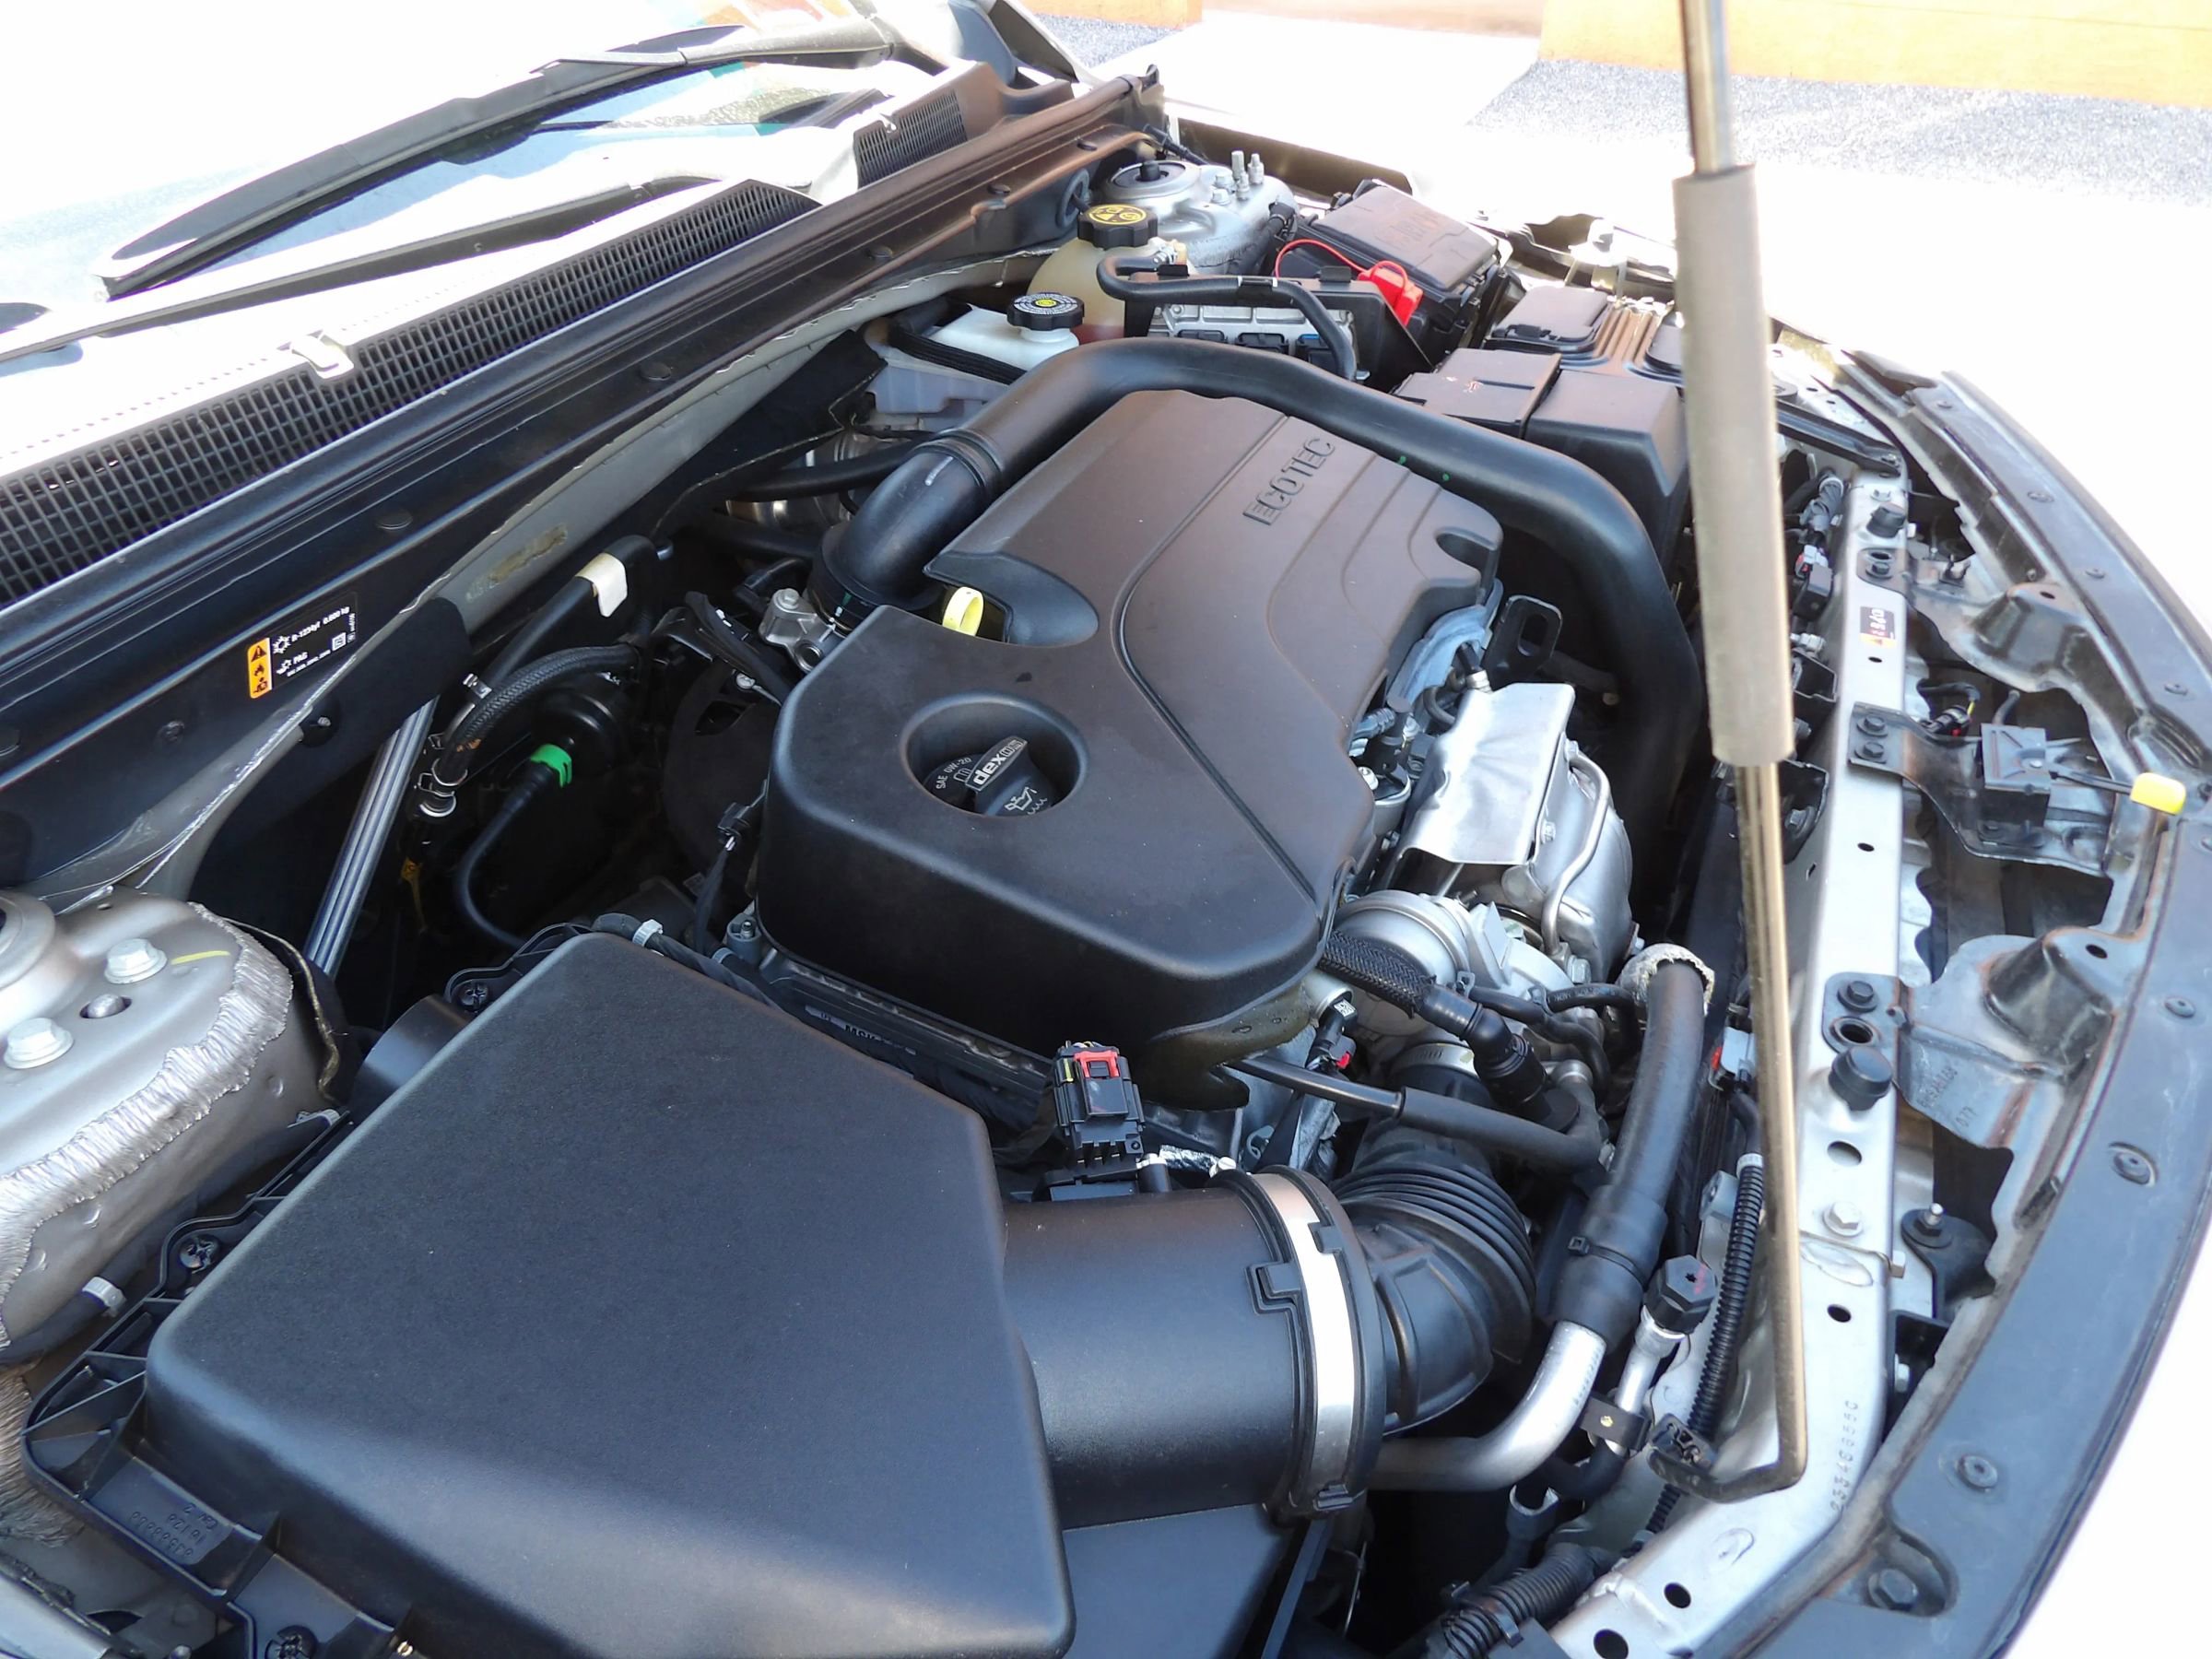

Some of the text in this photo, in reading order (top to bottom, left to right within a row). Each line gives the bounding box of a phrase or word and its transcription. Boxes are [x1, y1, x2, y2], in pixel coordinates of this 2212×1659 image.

[1241, 438, 1335, 526] ECOTEC
[935, 775, 948, 790] SAE
[973, 739, 1024, 786] dexos
